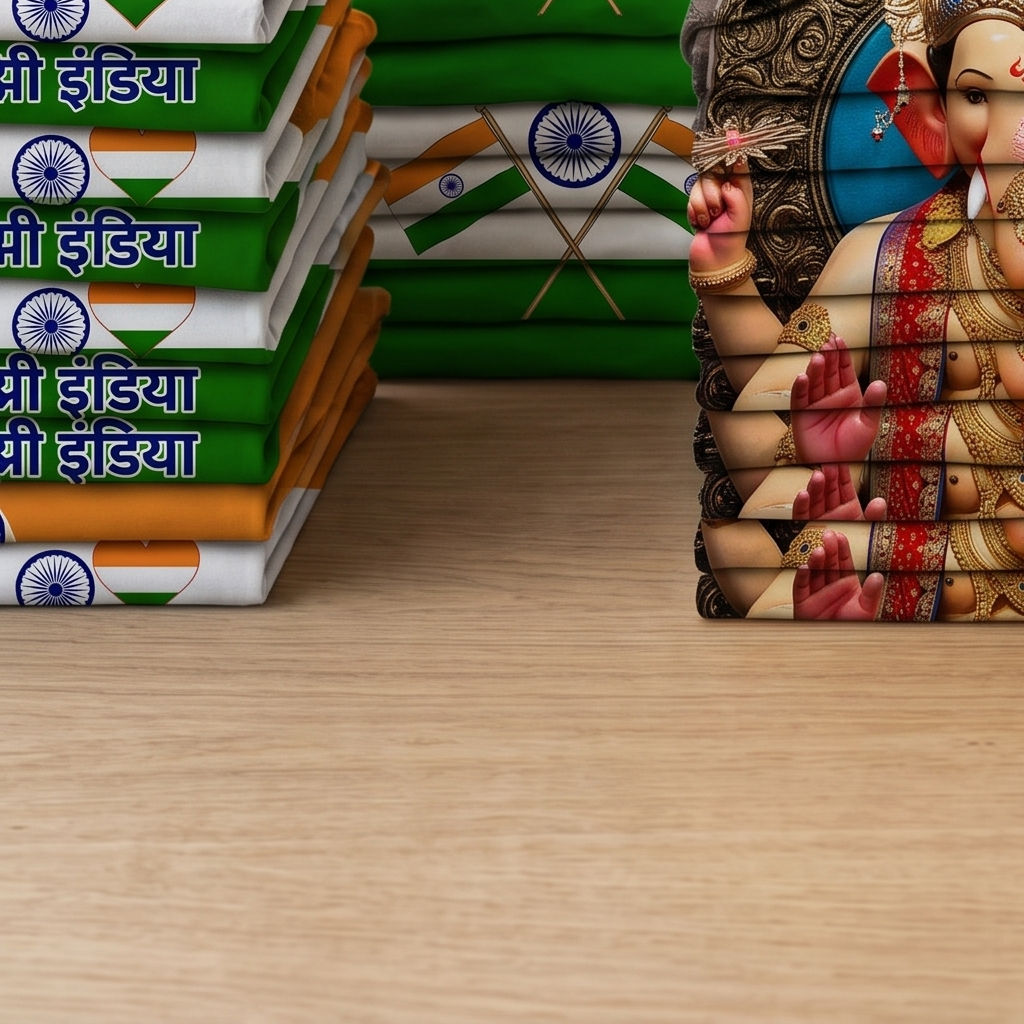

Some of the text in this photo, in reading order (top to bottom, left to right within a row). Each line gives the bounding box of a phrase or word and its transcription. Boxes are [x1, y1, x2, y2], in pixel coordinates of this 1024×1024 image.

[55, 44, 200, 112] इंडिया
[55, 206, 200, 277] इंडिया
[55, 352, 200, 419] इंडिया
[55, 416, 200, 484] इंडिया
